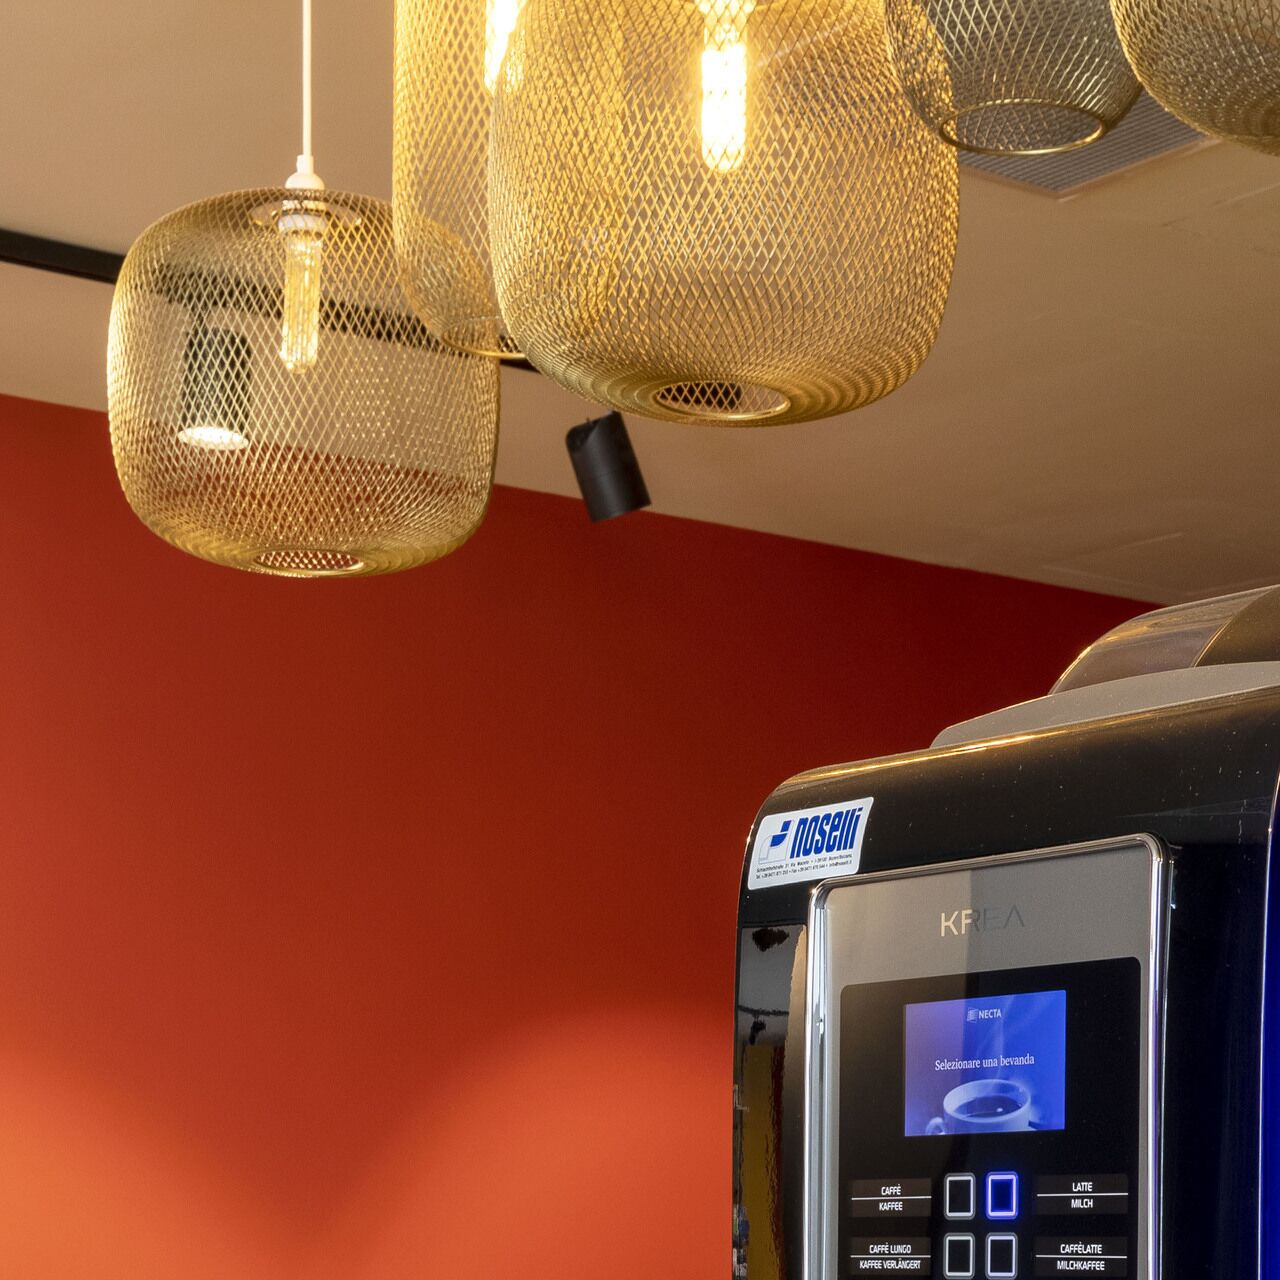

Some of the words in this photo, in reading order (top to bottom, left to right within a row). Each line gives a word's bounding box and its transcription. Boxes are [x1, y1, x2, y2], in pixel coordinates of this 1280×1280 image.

[790, 807, 864, 859] noselli
[979, 1009, 1002, 1019] NECTA
[935, 1059, 980, 1071] Selezionare
[982, 1059, 998, 1068] una
[1000, 1053, 1035, 1066] bevanda
[881, 1185, 901, 1195] CAFFÈ
[1071, 1181, 1093, 1192] LATTE
[878, 1202, 903, 1211] KAFFEE
[1071, 1198, 1094, 1208] MILCH
[869, 1243, 889, 1254] CAFFÈ
[891, 1244, 912, 1254] LUNGO
[1060, 1242, 1103, 1253] CAFFÈLATTE
[859, 1260, 881, 1269] KAFFEE
[882, 1259, 921, 1270] VERLÄNGERT
[1056, 1261, 1105, 1270] MILCHKAFFEE
